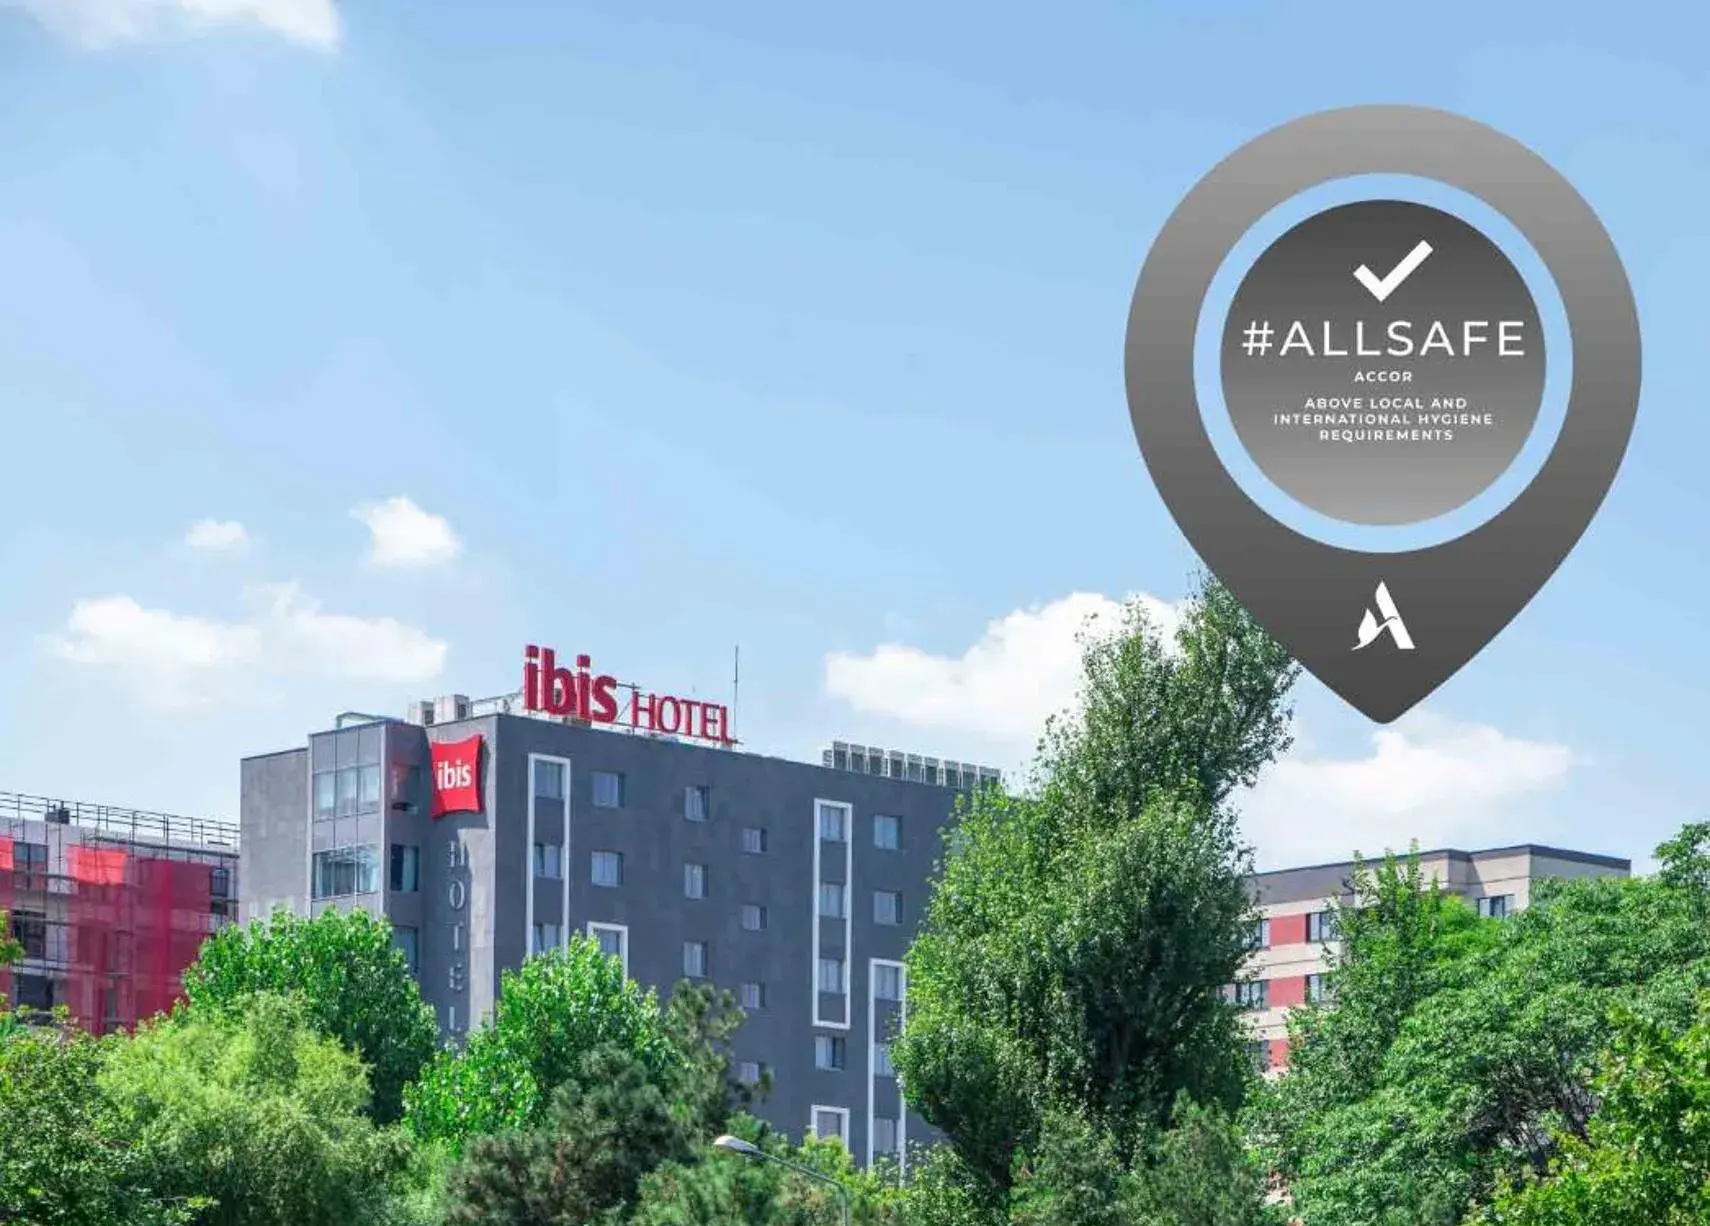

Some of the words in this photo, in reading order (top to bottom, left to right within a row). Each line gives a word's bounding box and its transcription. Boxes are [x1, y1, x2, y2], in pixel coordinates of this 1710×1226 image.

[522, 644, 618, 724] ibis
[631, 690, 736, 745] HOTEL
[436, 757, 472, 791] ibis
